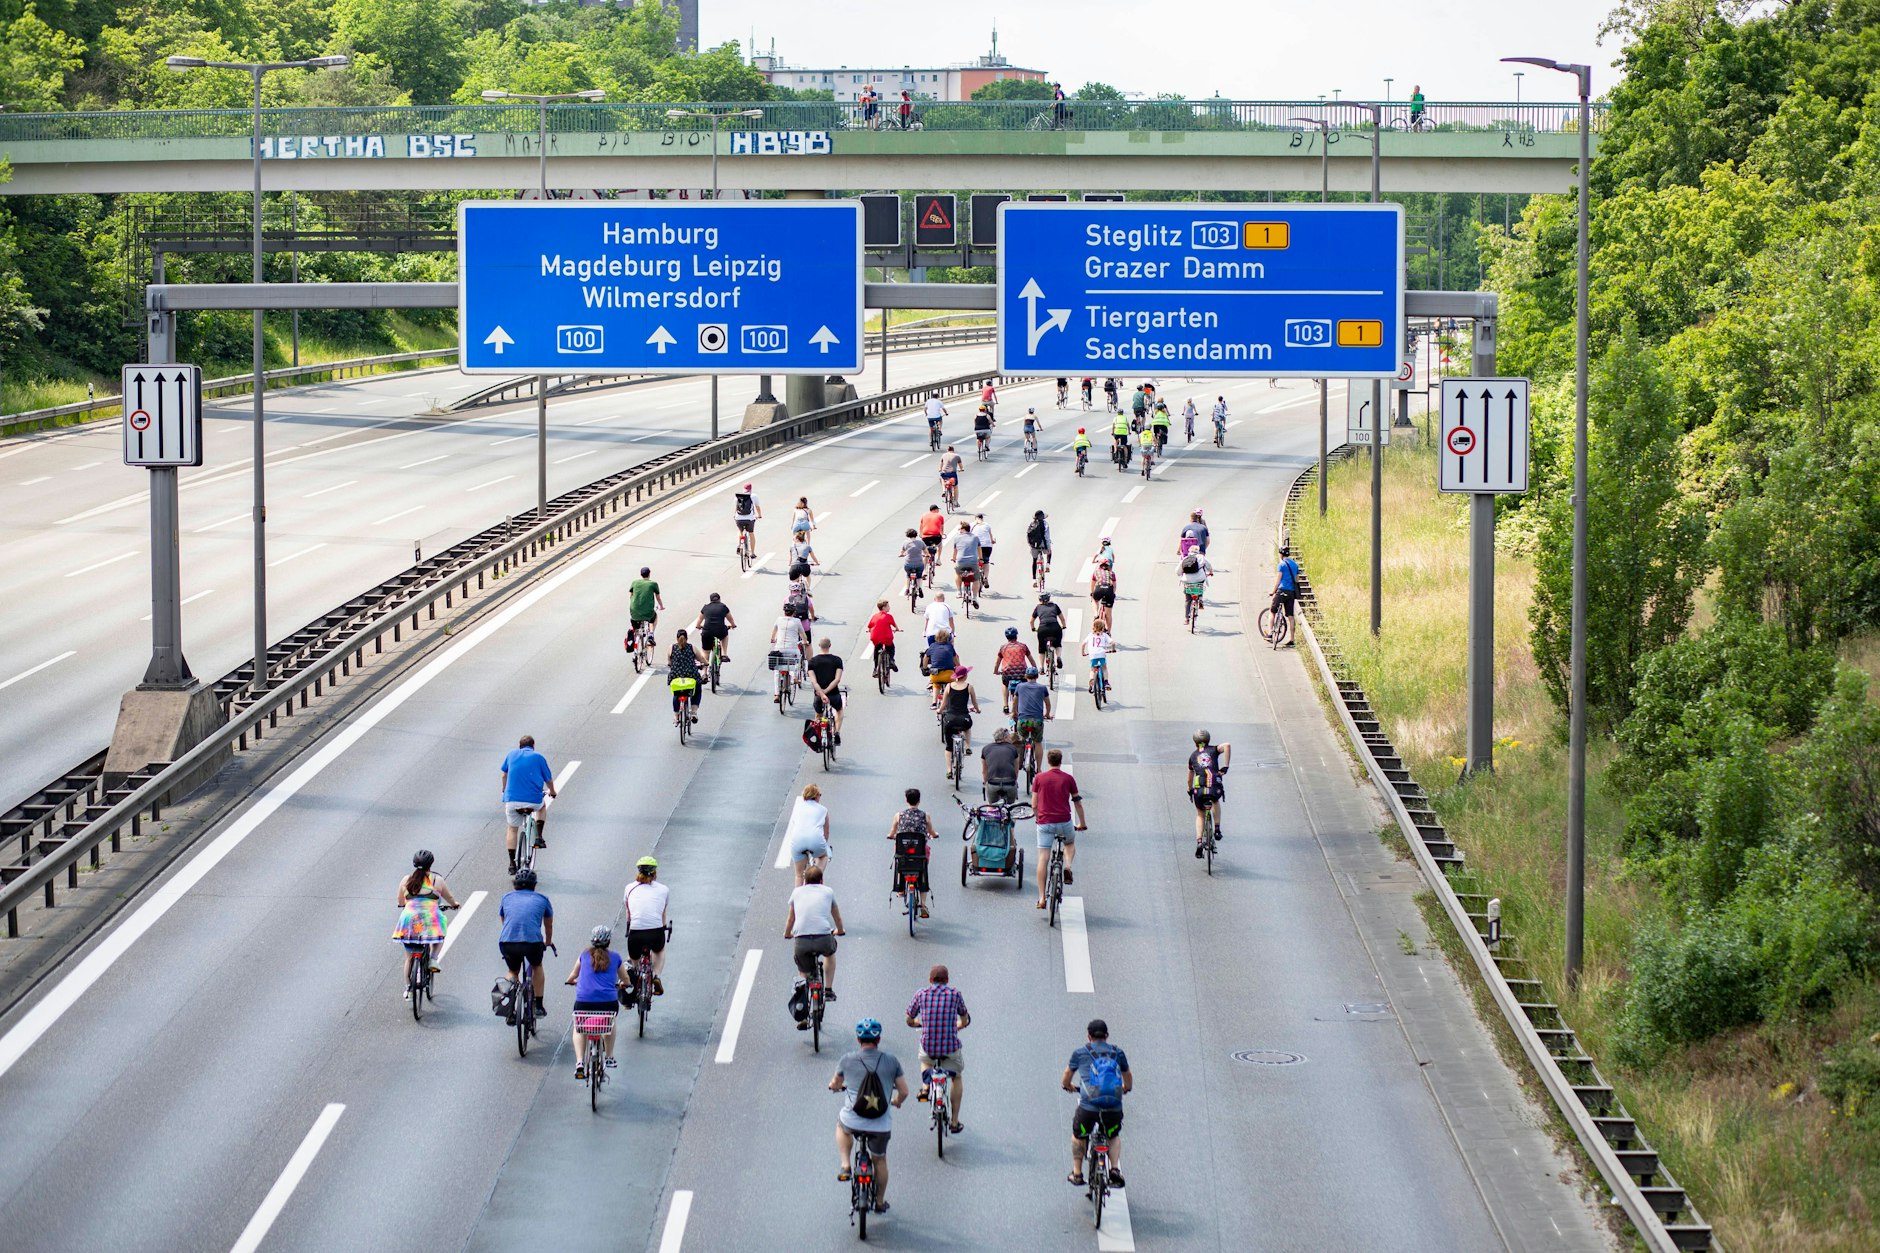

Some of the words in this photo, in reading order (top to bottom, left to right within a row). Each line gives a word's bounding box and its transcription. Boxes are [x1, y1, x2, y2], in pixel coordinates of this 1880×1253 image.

[251, 134, 386, 159] HERTHA
[407, 133, 477, 158] BSC
[603, 222, 719, 251] Hamburg
[1086, 223, 1183, 252] Steglitz
[1200, 227, 1230, 244] 103
[1264, 227, 1270, 244] 1
[541, 254, 682, 283] Magdeburg
[693, 254, 782, 283] Leipzig
[1085, 256, 1171, 279] Grazer
[1184, 256, 1265, 279] Damm
[582, 286, 741, 309] Wilmersdorf
[1085, 305, 1219, 333] Tiergarten
[565, 331, 596, 348] 100
[749, 331, 780, 348] 100
[1293, 324, 1323, 342] 103
[1357, 325, 1363, 342] 1
[1085, 337, 1273, 361] Sachsendamm
[1355, 432, 1370, 441] 100
[1092, 637, 1101, 647] 19
